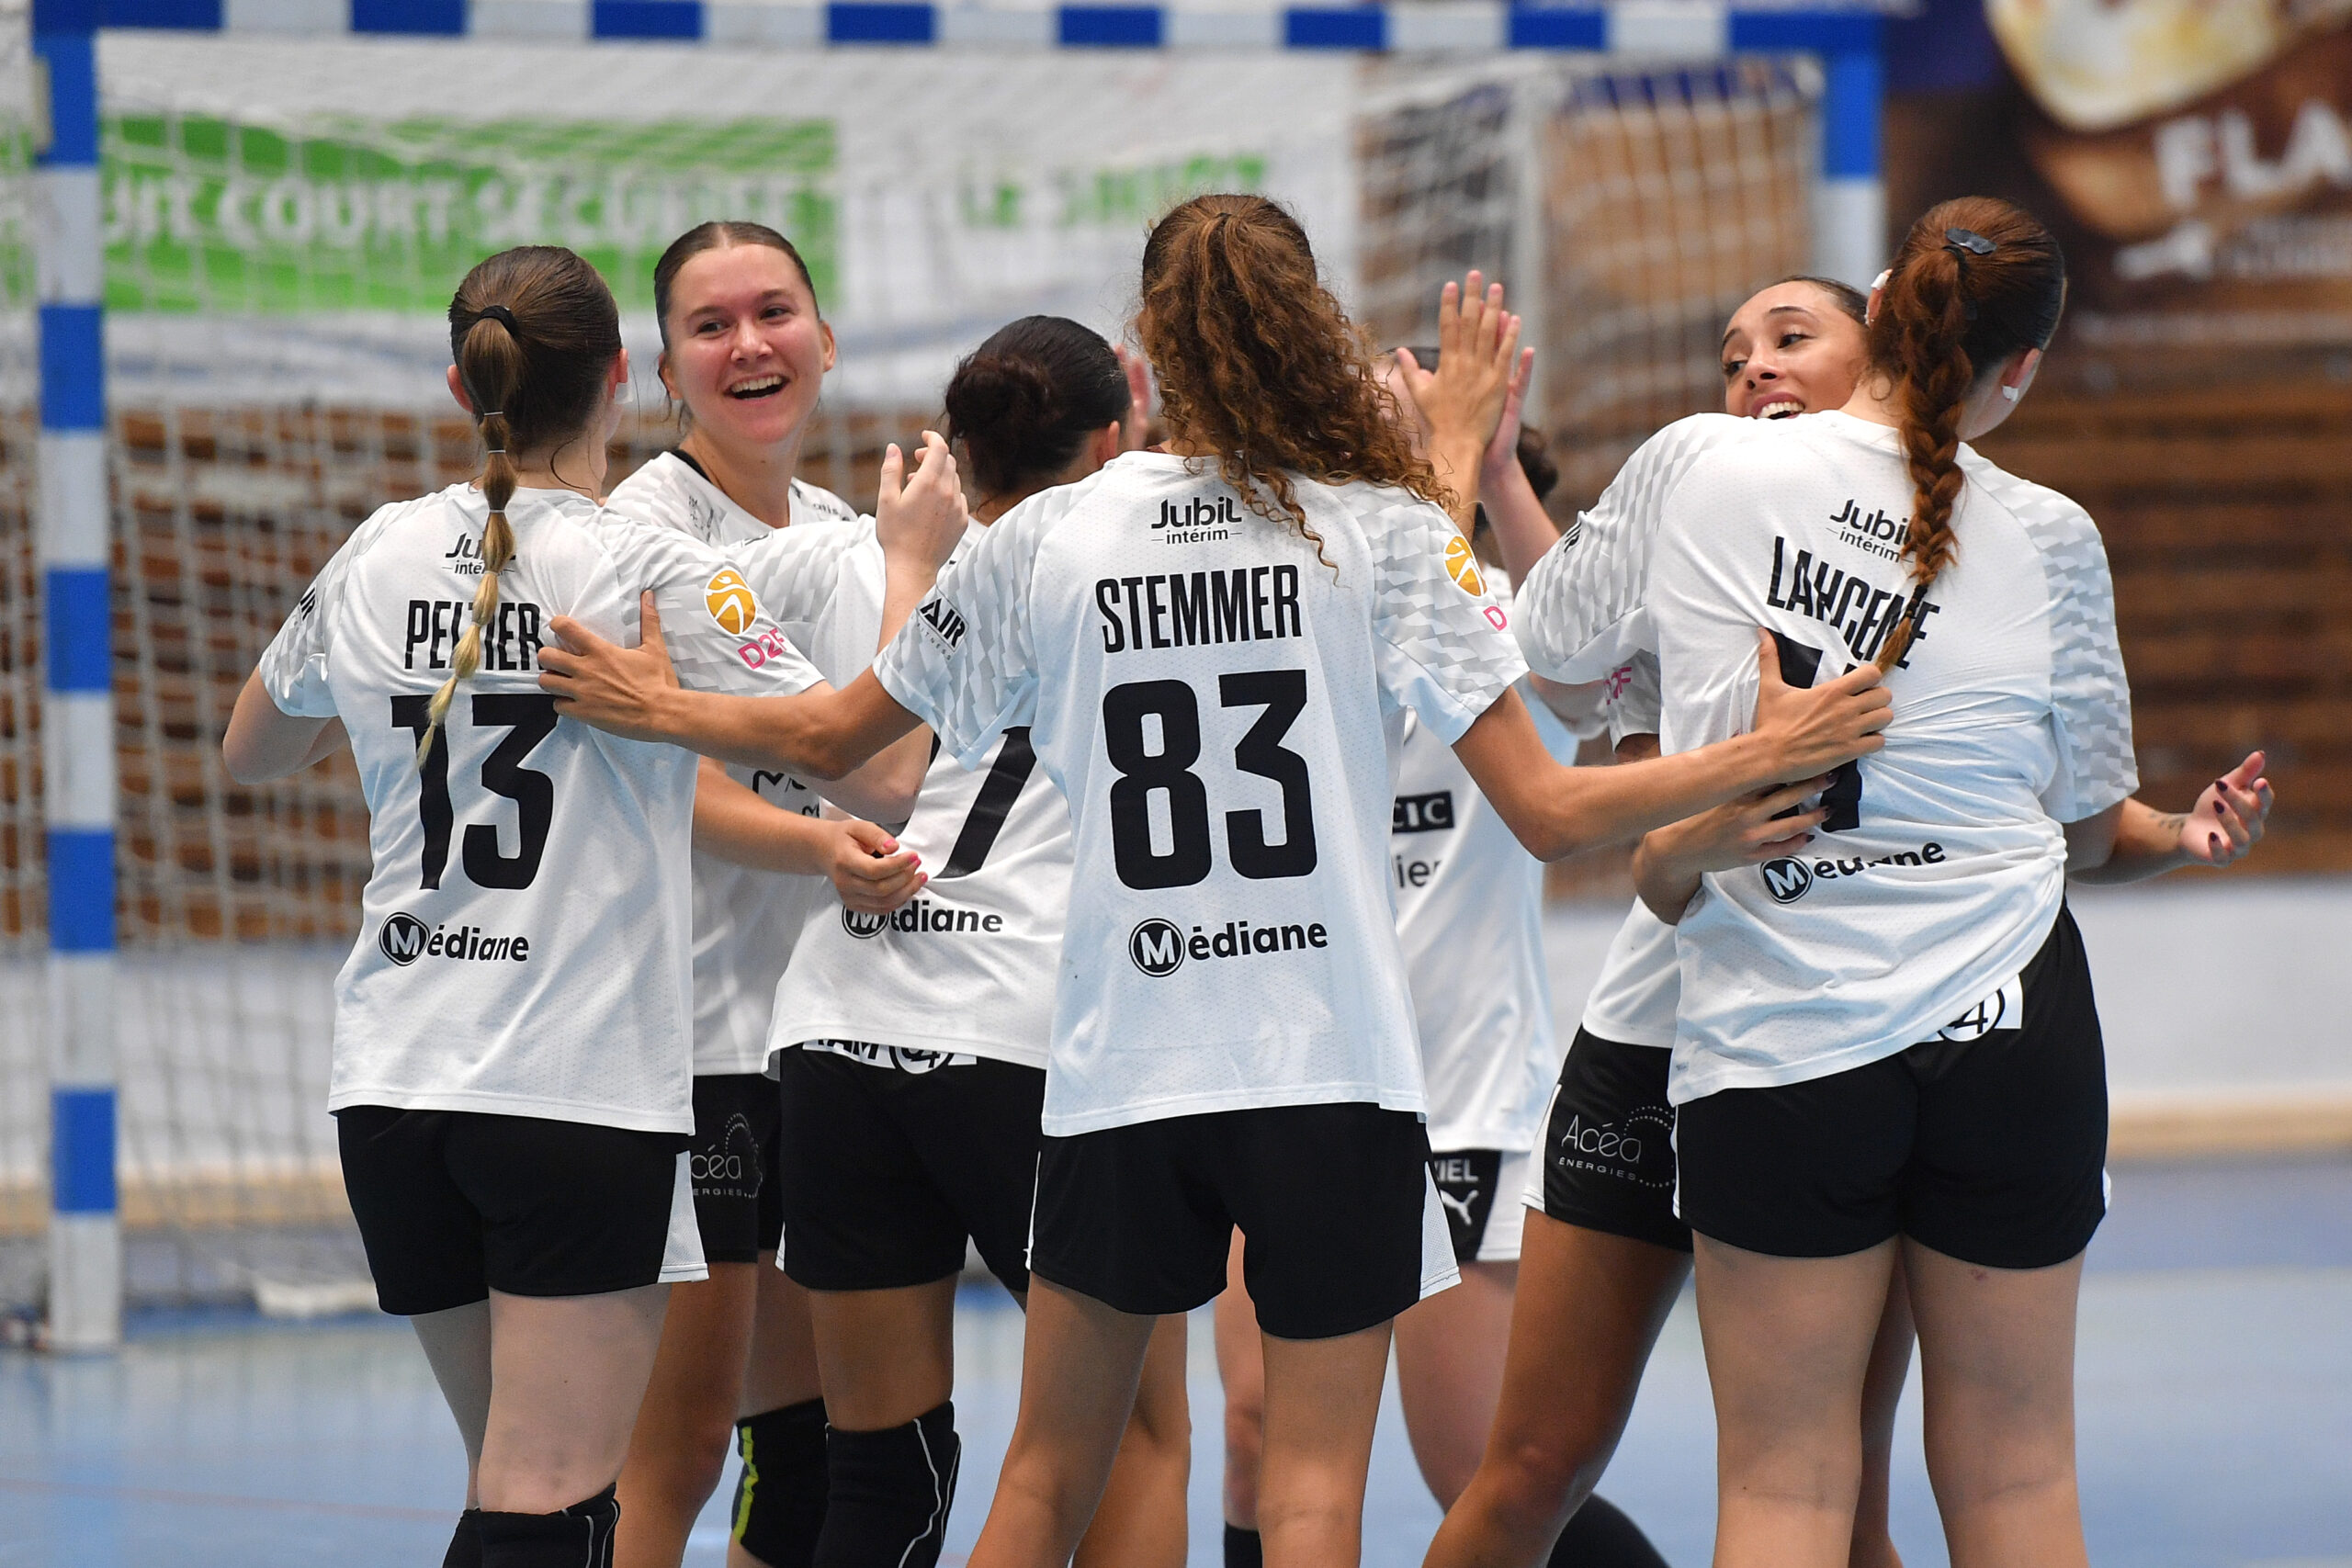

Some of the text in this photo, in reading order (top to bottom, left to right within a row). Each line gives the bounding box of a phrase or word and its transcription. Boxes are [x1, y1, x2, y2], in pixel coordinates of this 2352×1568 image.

[1167, 526, 1228, 544] intérim
[1829, 499, 1911, 546] Jubi
[1840, 527, 1901, 563] intérim
[920, 598, 966, 649] AIR
[1095, 564, 1302, 653] STEMMER
[405, 600, 548, 671] PELIER
[738, 627, 786, 670] D2F
[390, 694, 558, 890] 13
[1102, 669, 1317, 890] 83
[379, 911, 529, 966] Médiane
[1129, 918, 1329, 977] Médiane
[690, 1144, 742, 1179] céa
[1562, 1114, 1642, 1164] Acéa
